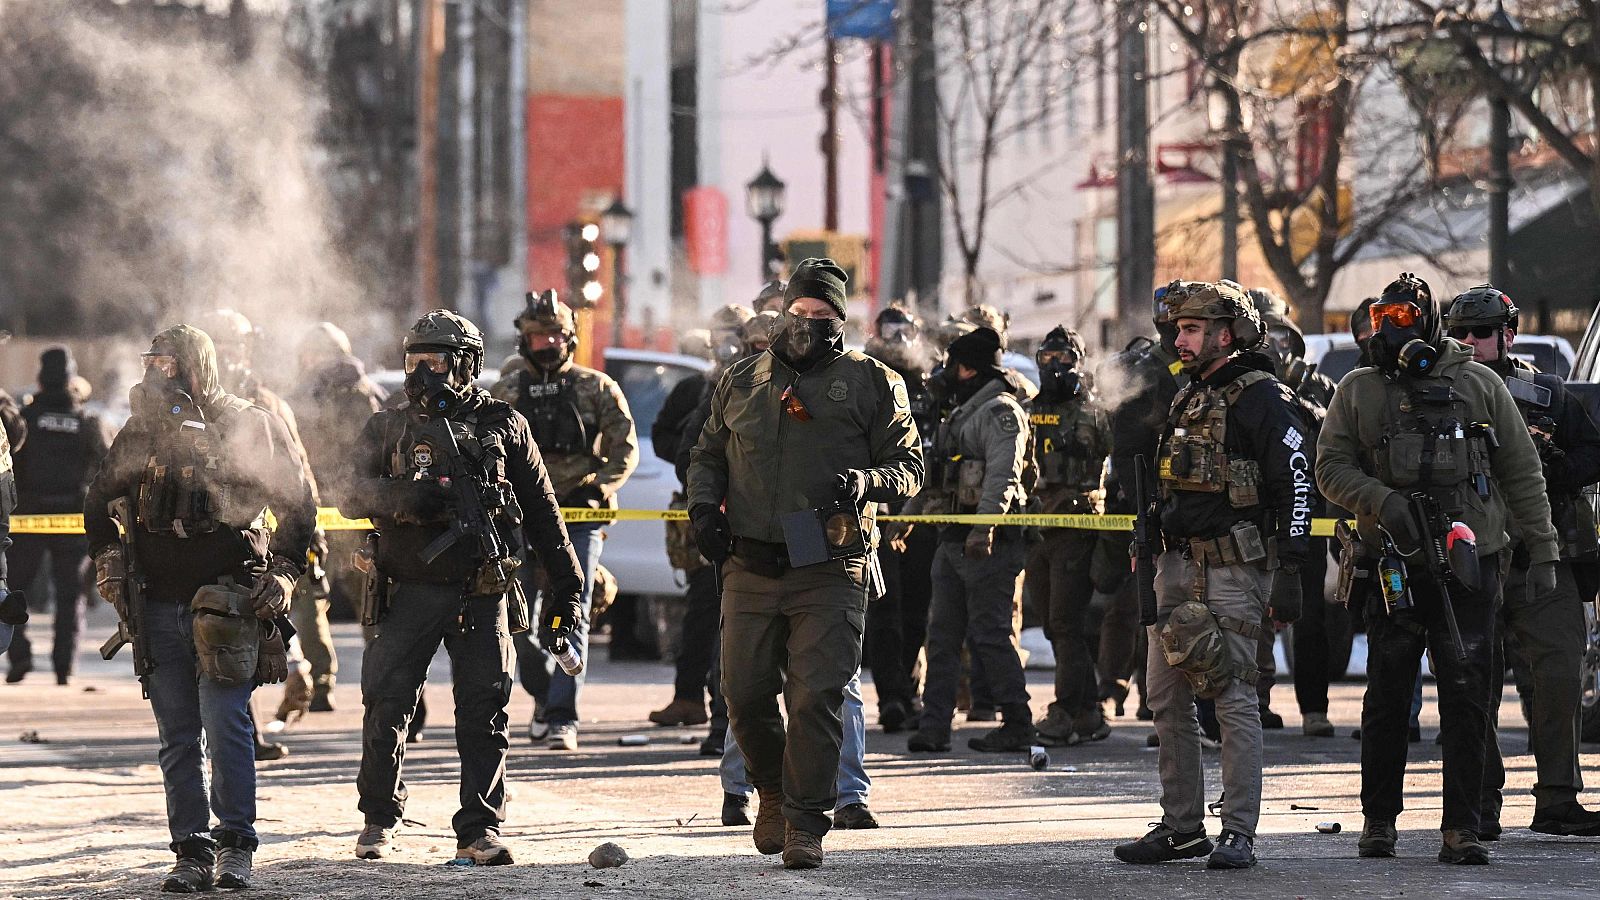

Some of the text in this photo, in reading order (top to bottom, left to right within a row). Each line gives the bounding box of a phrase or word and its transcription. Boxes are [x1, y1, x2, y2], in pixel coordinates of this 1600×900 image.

[565, 510, 617, 519] NOT CROSS
[1289, 451, 1311, 537] Columbia
